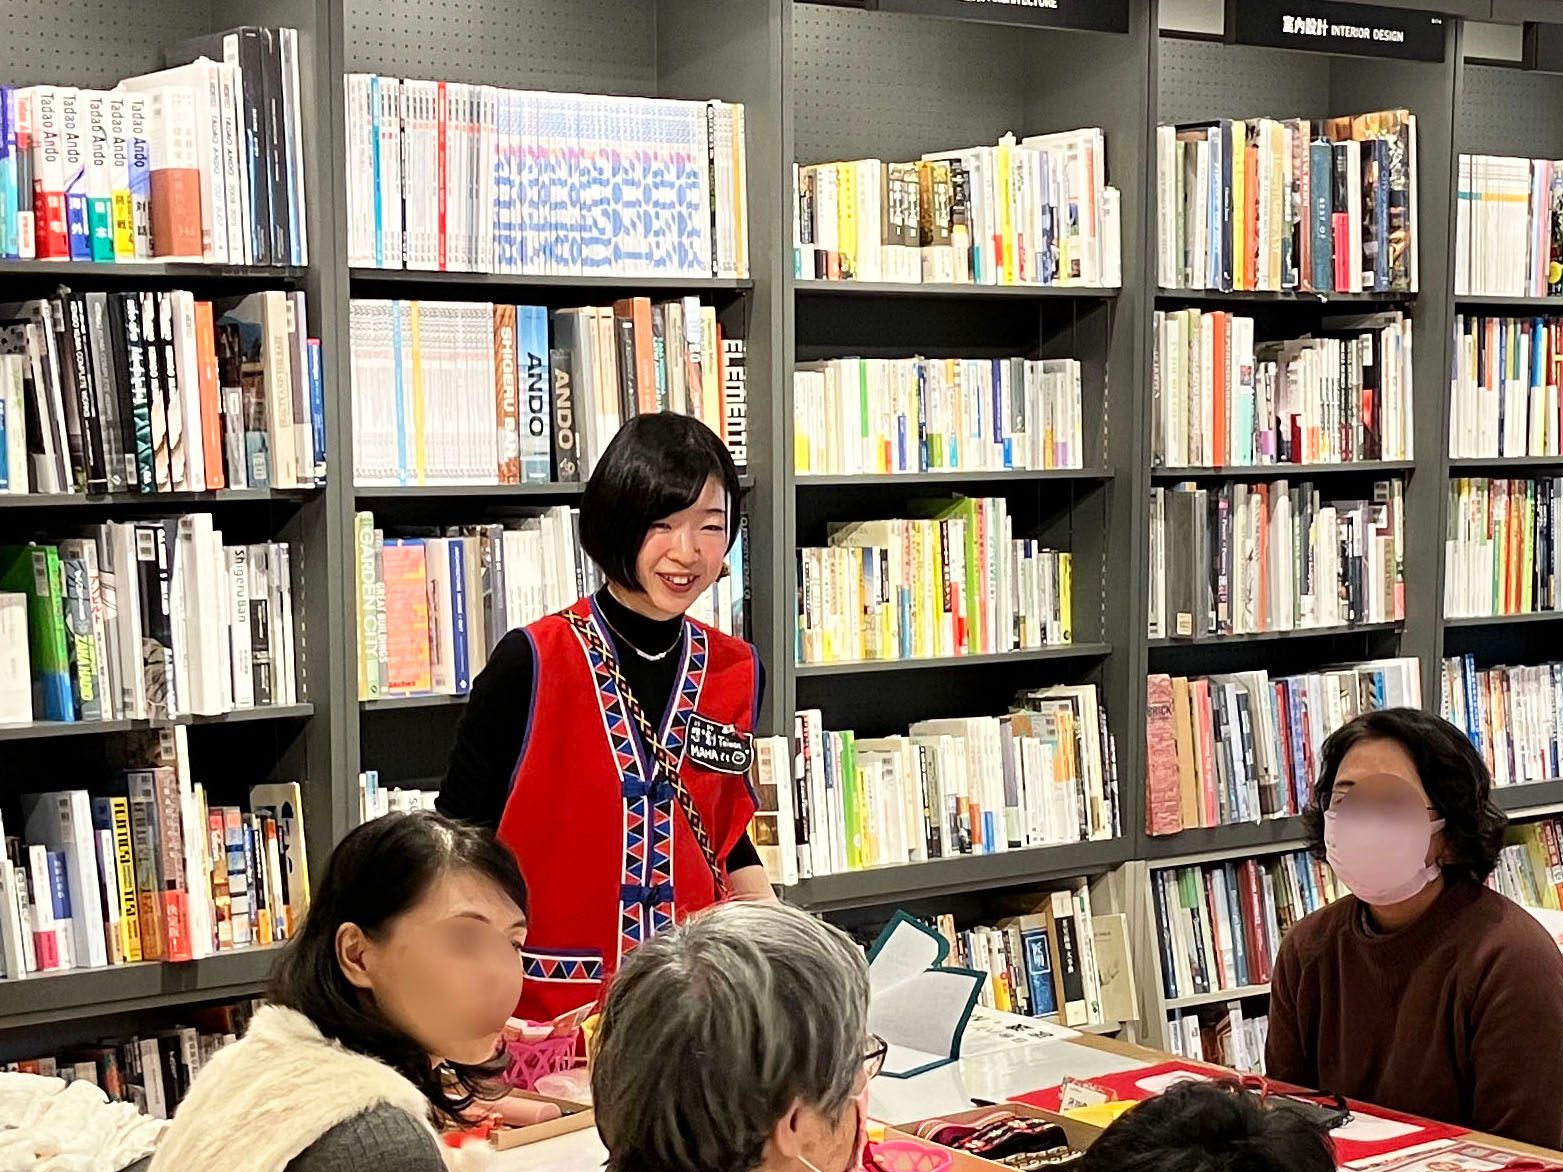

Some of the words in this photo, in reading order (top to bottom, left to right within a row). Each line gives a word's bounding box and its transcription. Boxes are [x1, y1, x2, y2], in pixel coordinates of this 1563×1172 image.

[1331, 24, 1371, 40] INTERIOR
[1373, 29, 1405, 43] DESIGN
[40, 93, 55, 129] Tadao
[63, 94, 77, 130] Tadao
[90, 97, 103, 133] Tadao
[110, 99, 124, 135] Tadao
[131, 99, 145, 135] Tadao
[43, 130, 60, 163] Ando
[66, 132, 81, 164] Ando
[92, 135, 107, 166] Ando
[113, 136, 128, 167] Ando
[134, 136, 148, 168] Ando
[70, 300, 79, 327] KENGO
[74, 329, 83, 351] KUMA
[76, 351, 87, 389] COMPLETE
[500, 326, 515, 413] SHIGERU
[81, 390, 91, 418] WORKS
[527, 352, 544, 437] ANDO
[554, 368, 574, 450] ANDO
[234, 550, 246, 598] Shigeru
[359, 528, 377, 611] GARDEN
[238, 599, 247, 623] Ban
[375, 581, 386, 610] GREAT
[74, 635, 91, 665] ZAHA
[363, 615, 378, 659] CITY
[377, 611, 388, 663] BUILDINGS
[79, 665, 94, 701] HADID
